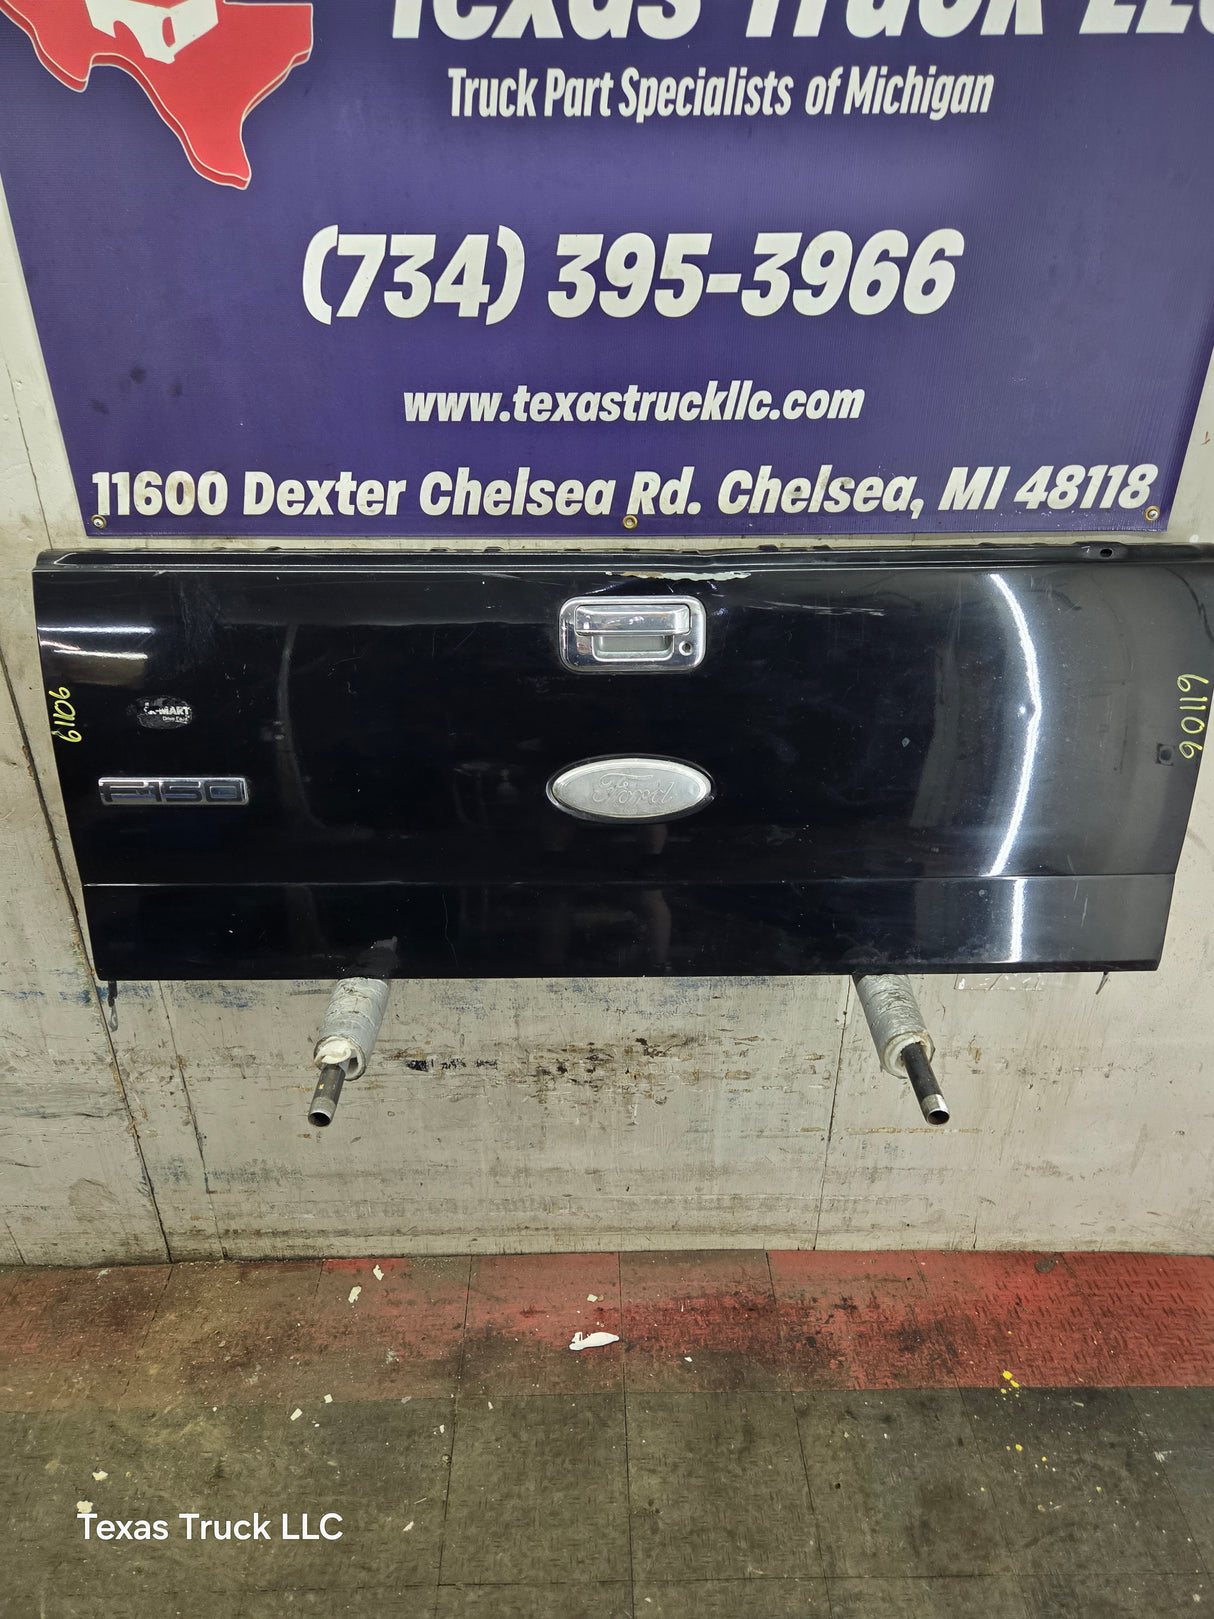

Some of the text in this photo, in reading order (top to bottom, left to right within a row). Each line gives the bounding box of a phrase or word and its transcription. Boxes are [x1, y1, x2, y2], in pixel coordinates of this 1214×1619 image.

[447, 64, 995, 124] Truck Part Specialists of Michigan
[302, 224, 965, 326] (734) 395-3966
[403, 379, 866, 422] www.texastruckllc.com
[91, 463, 1159, 520] 11600 Dexter Chelsea Rd. Chelsea, MI 48118
[49, 686, 82, 743] 61106
[1177, 673, 1209, 759] 61106
[592, 772, 675, 804] Ford
